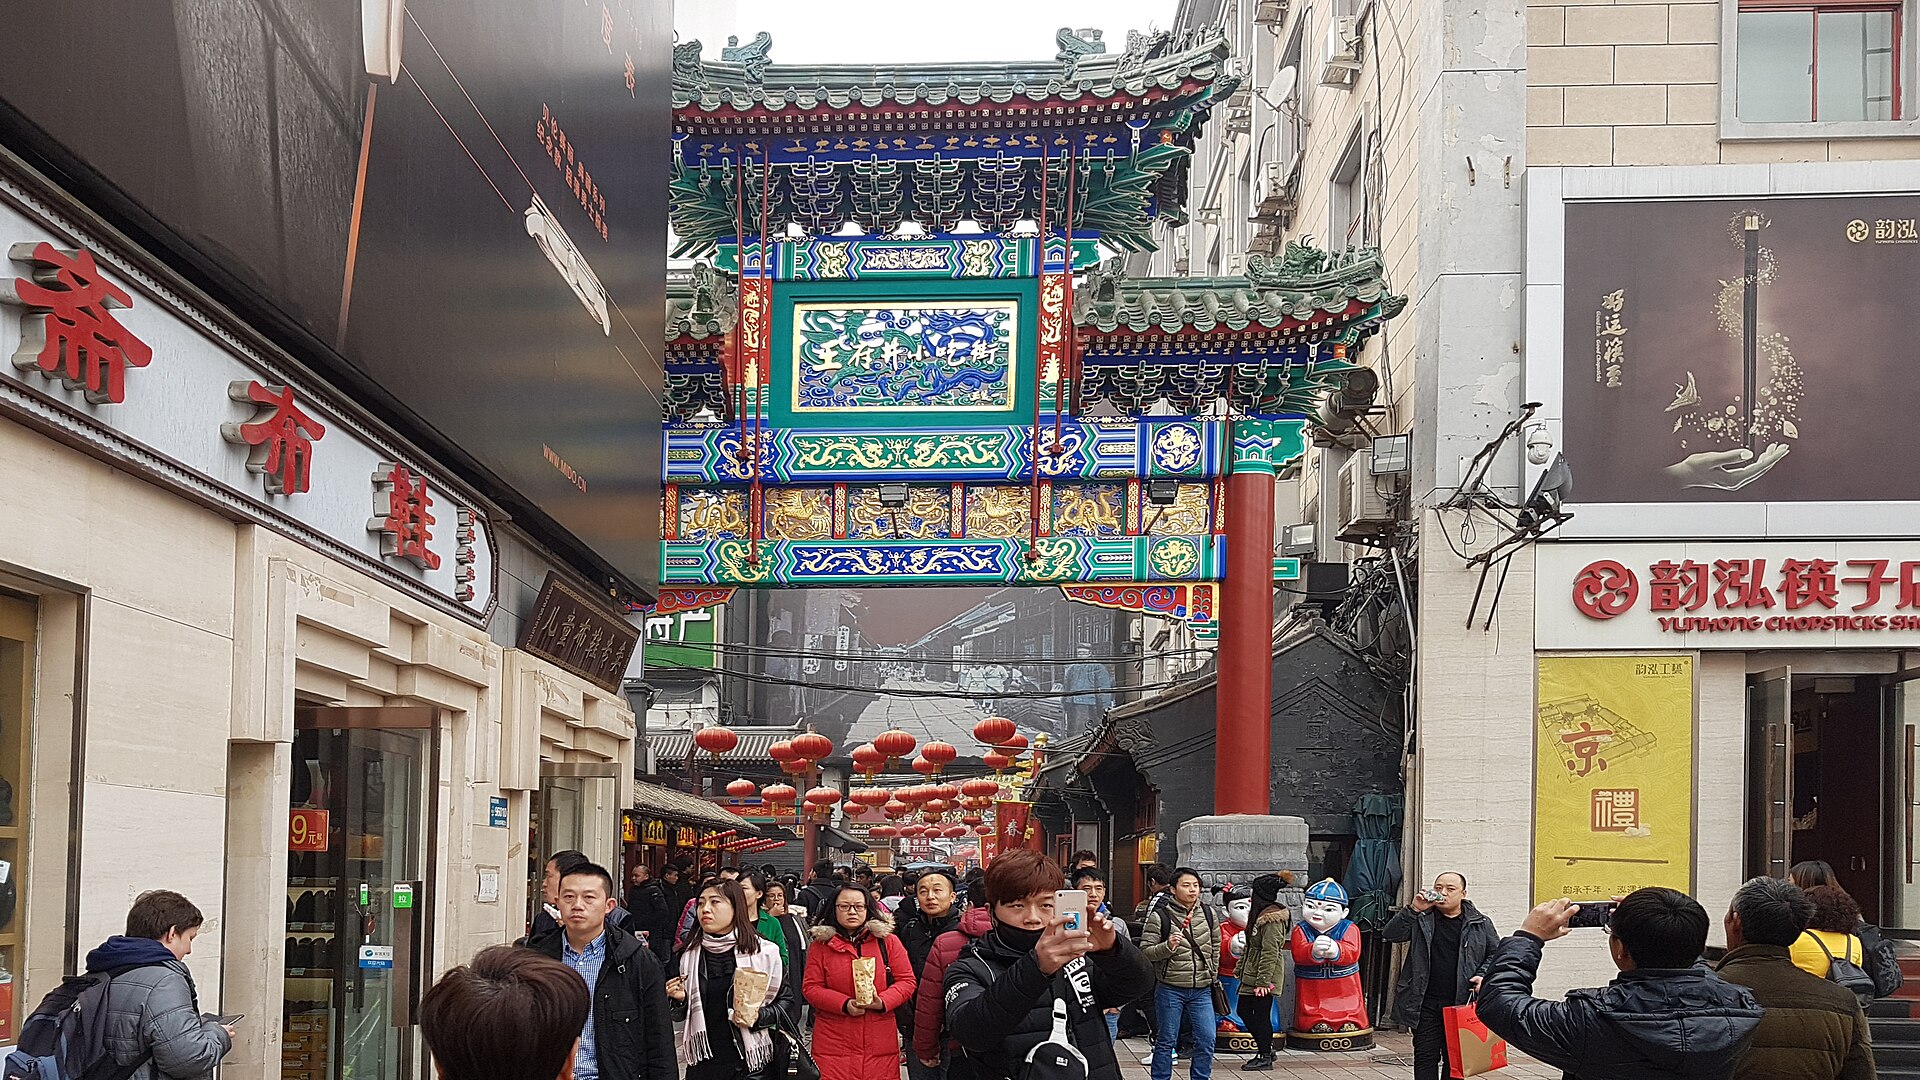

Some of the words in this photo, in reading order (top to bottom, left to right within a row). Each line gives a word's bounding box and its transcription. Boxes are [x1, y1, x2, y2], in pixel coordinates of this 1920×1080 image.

[1875, 219, 1918, 239] 韵泓
[811, 339, 999, 371] 王府井小吃街
[14, 241, 442, 571] 斋布鞋
[543, 443, 587, 493] WWW.MIDO.CN
[1658, 615, 1763, 632] YUNHONG
[1764, 615, 1888, 631] CHOPSTICKS
[1889, 615, 1920, 631] SH
[1561, 722, 1613, 777] 京
[1562, 885, 1602, 895] 韵承千年
